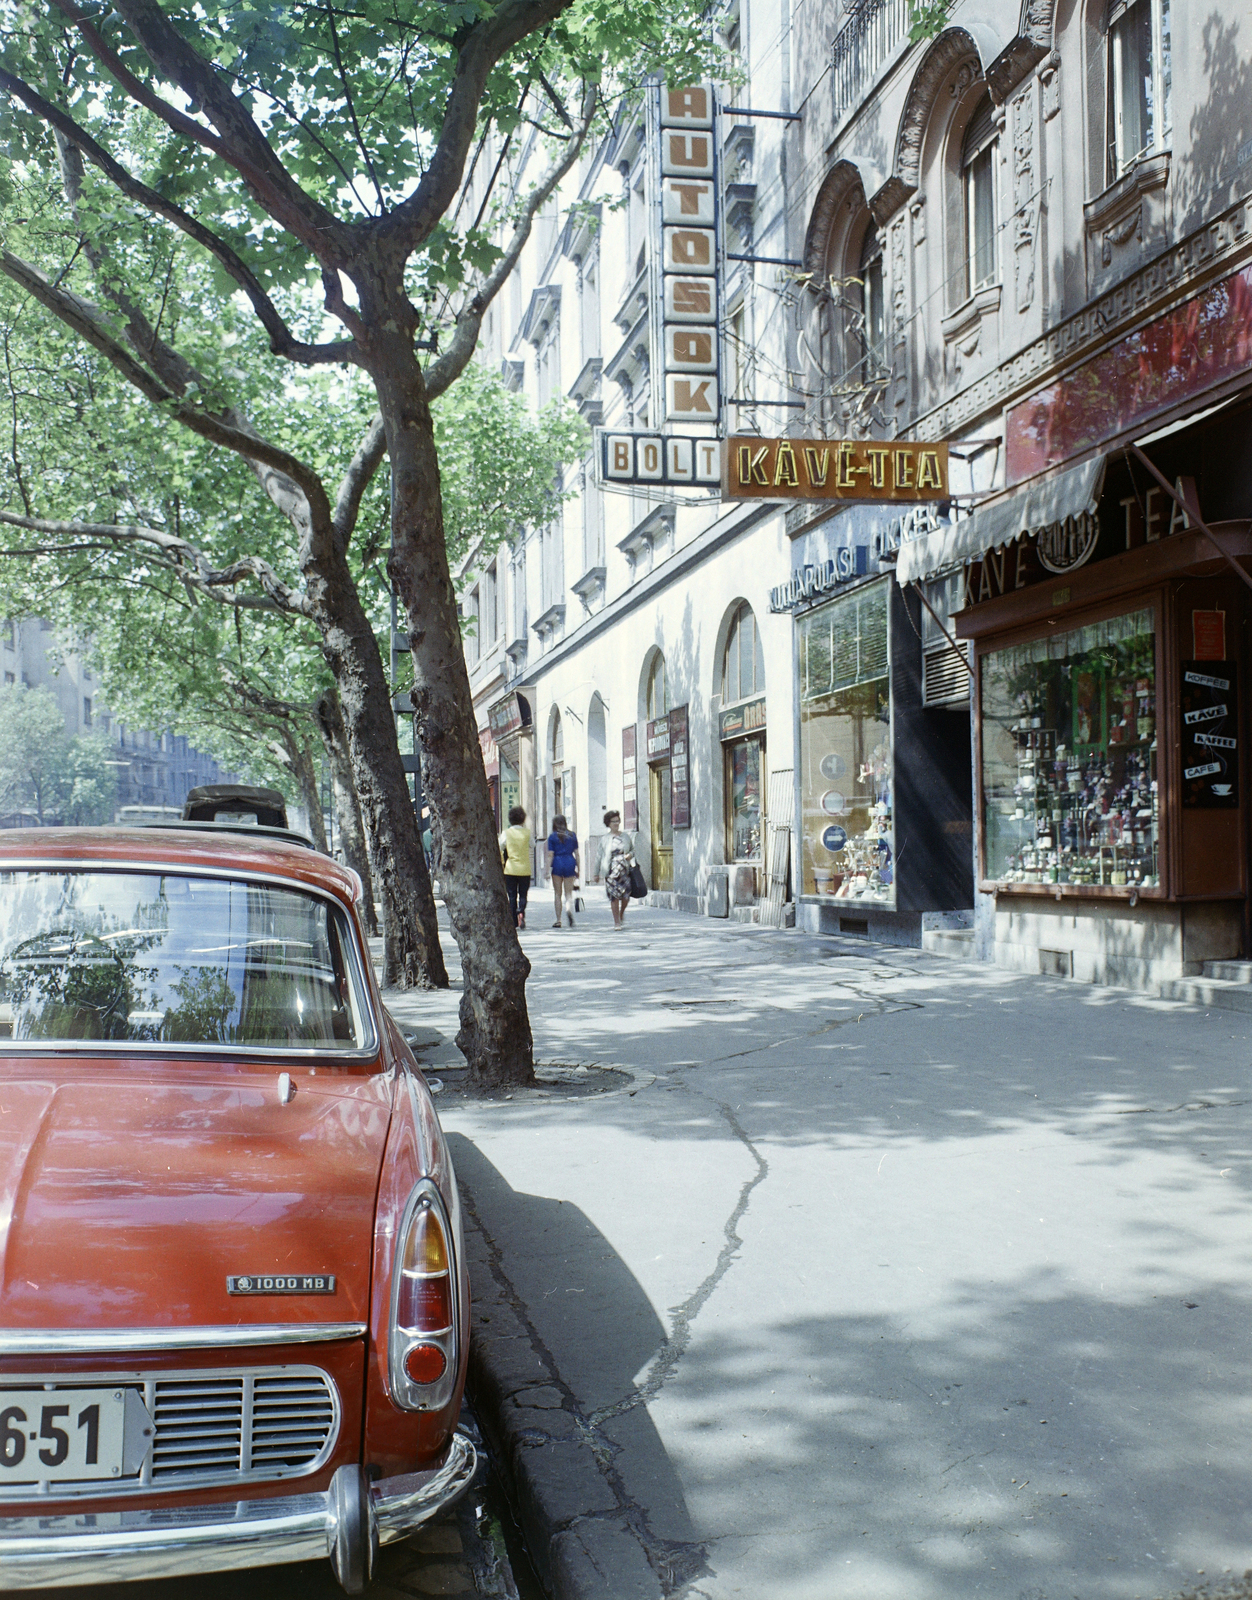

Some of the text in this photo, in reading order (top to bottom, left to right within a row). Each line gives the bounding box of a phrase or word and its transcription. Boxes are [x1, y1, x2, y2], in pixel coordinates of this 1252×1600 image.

[613, 442, 716, 477] BOLT
[1119, 476, 1191, 550] TEA
[1187, 674, 1227, 688] KOFFEE
[1197, 735, 1235, 747] KAFFEE
[257, 1278, 325, 1289] 1000 MB
